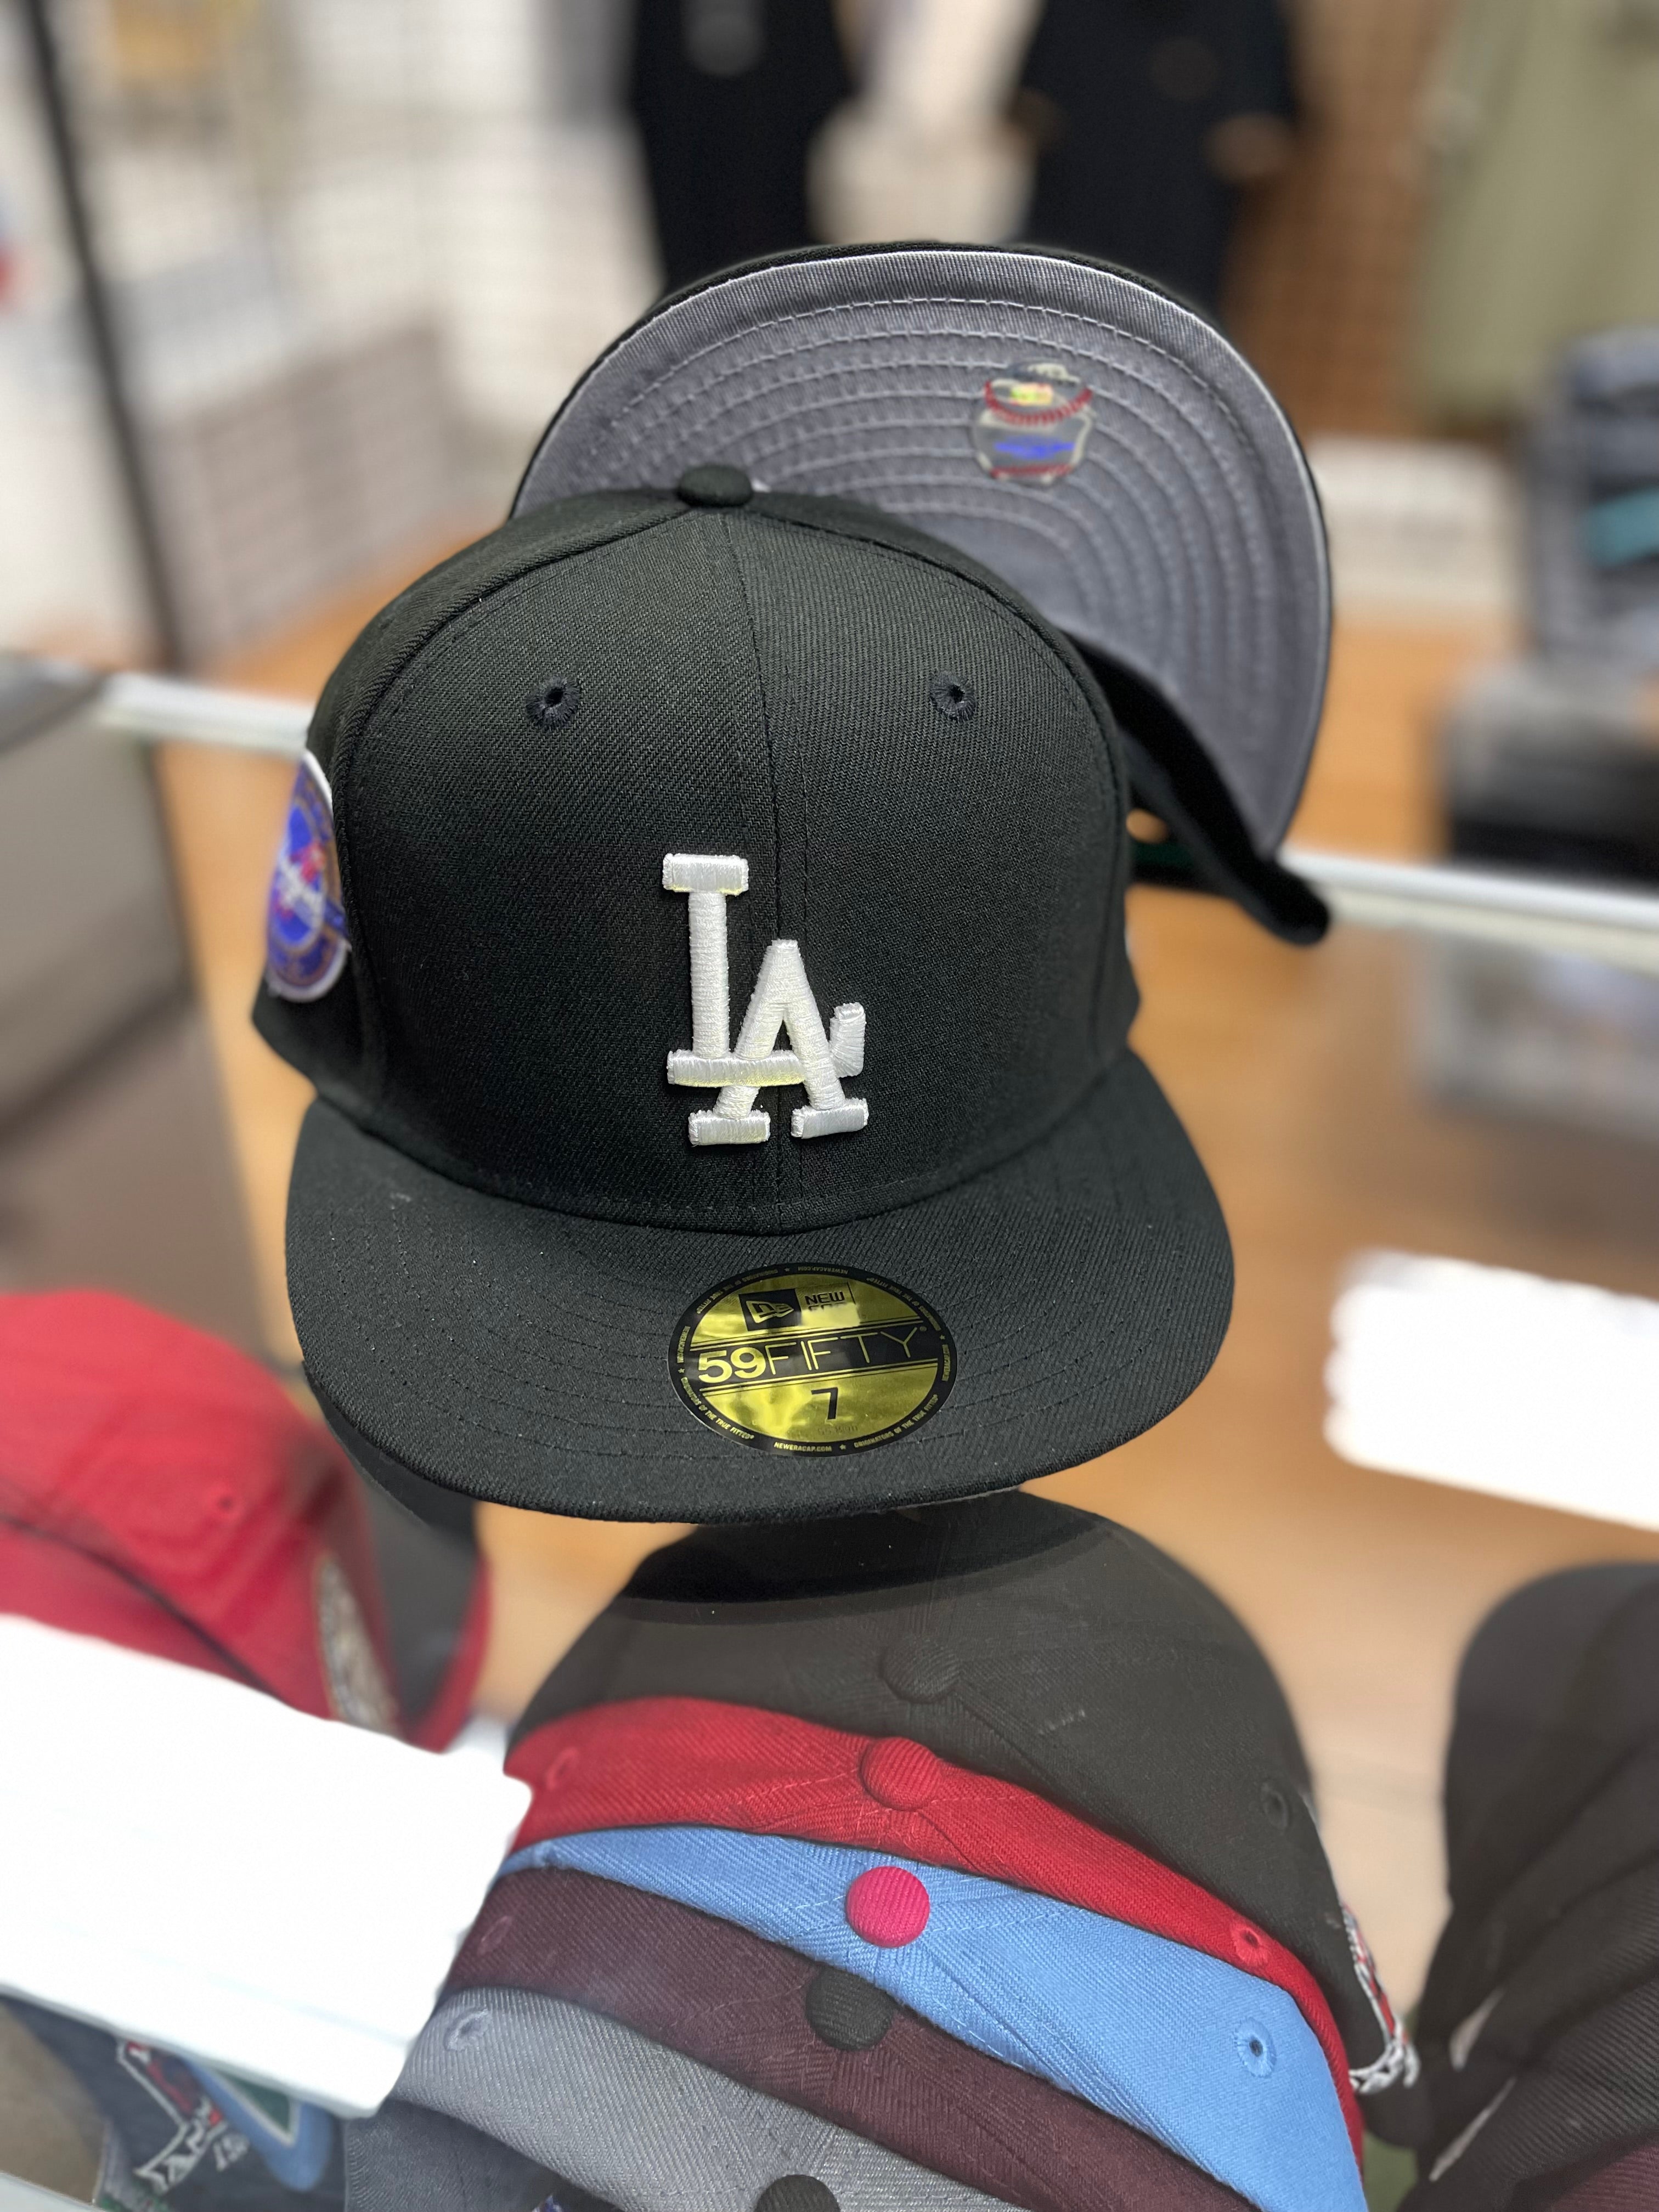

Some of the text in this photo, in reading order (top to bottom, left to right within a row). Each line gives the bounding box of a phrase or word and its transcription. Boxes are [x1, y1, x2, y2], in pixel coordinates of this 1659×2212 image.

[662, 853, 869, 1146] LA
[805, 1291, 845, 1305] NEW
[698, 1327, 918, 1384] 59FIFTY
[811, 1386, 839, 1420] 7
[774, 1442, 832, 1452] NEWERACAP.COM
